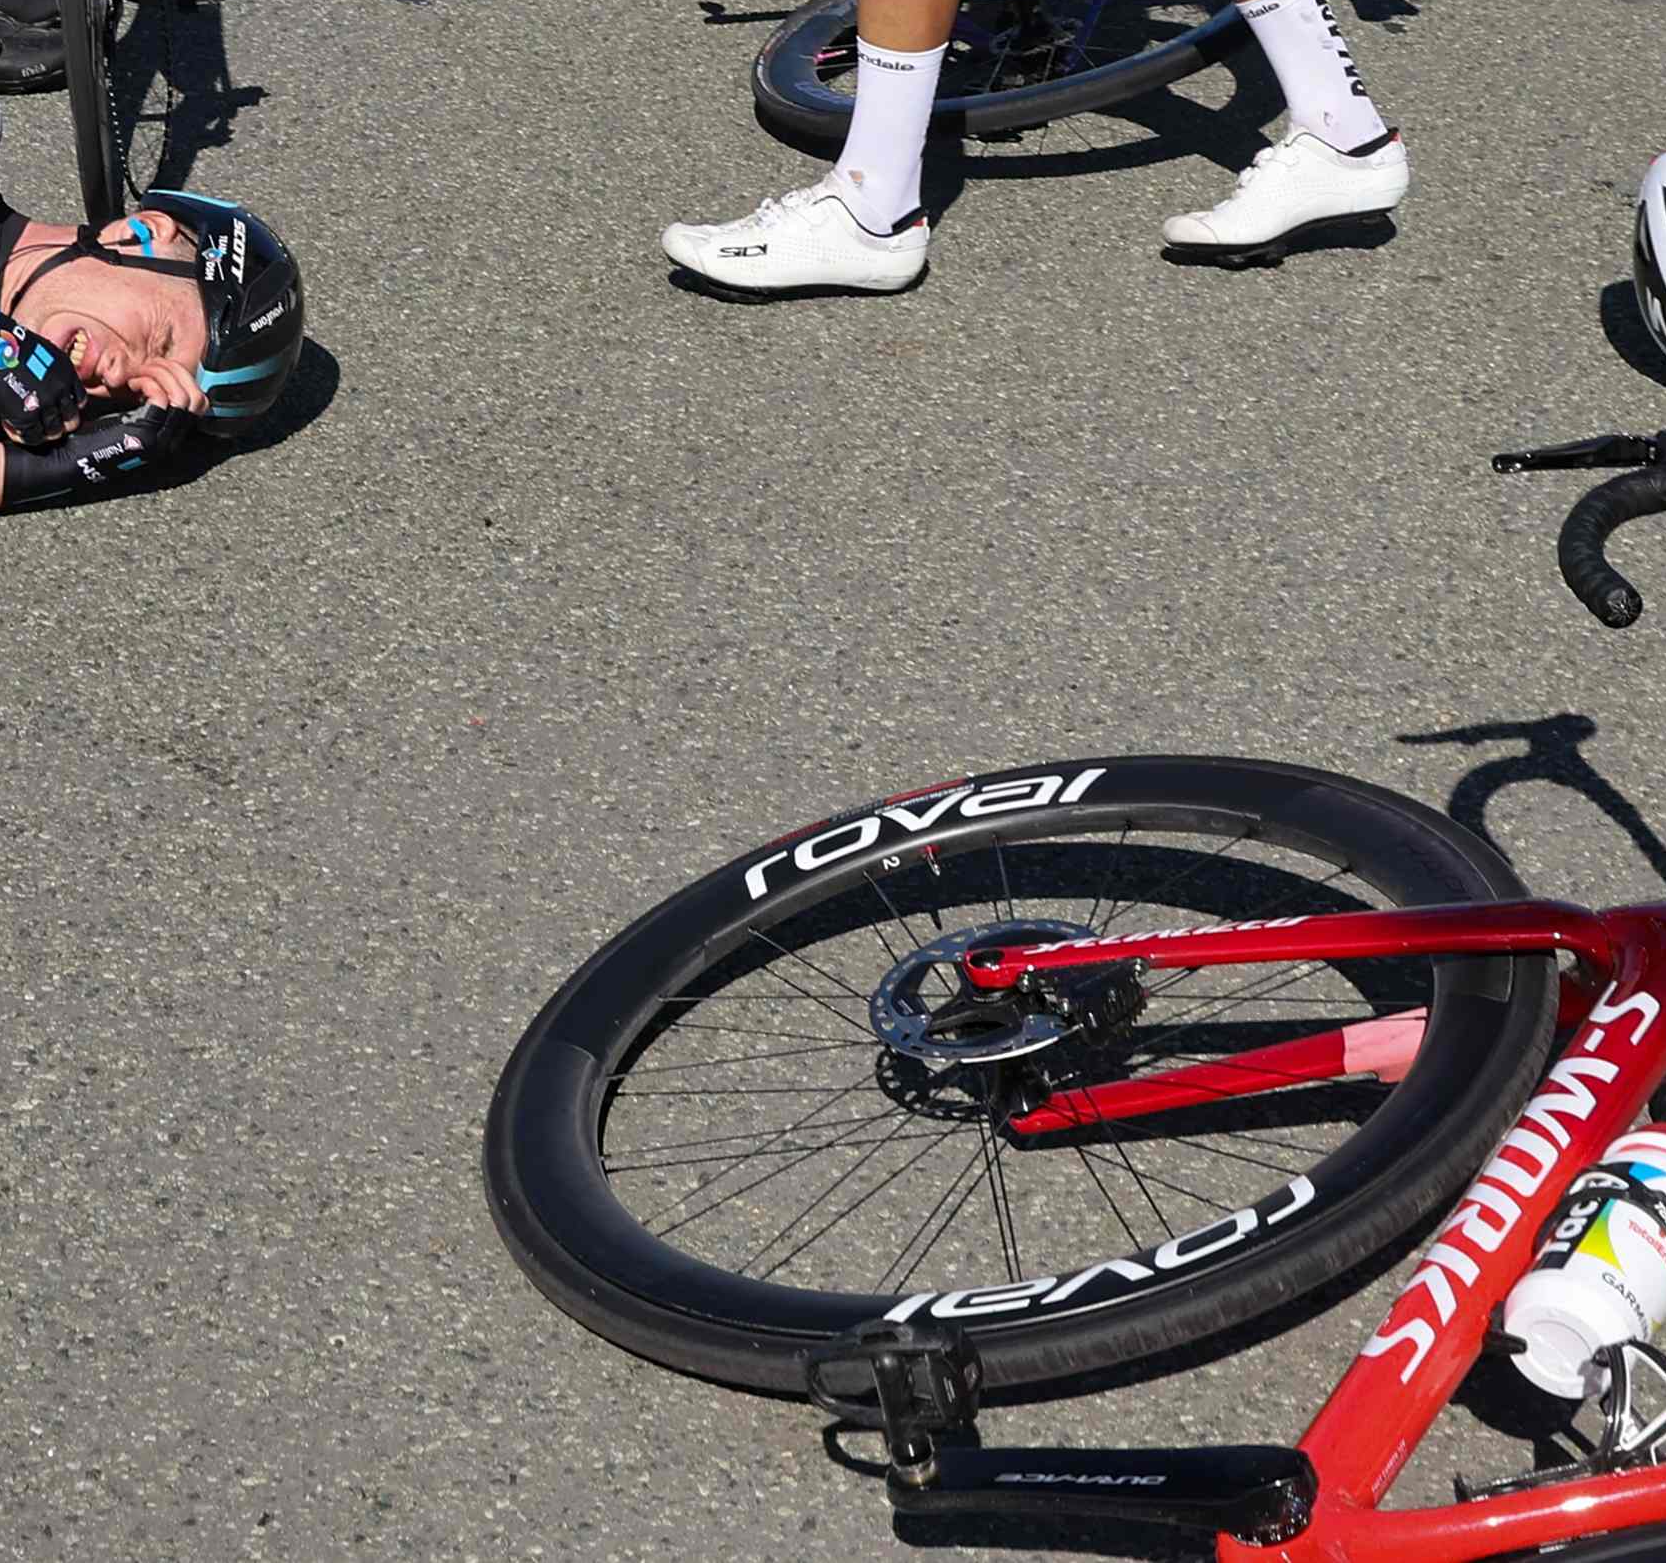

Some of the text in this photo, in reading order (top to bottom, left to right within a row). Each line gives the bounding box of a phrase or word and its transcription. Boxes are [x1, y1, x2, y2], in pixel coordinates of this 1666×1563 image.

[1244, 1, 1282, 20] dale
[857, 52, 916, 72] ndale
[231, 217, 247, 284] SCOTT
[203, 260, 215, 283] DSM
[249, 301, 286, 333] youfone
[742, 767, 1108, 901] roval
[881, 855, 901, 871] 2
[1360, 979, 1662, 1386] S-WORKS
[882, 1173, 1316, 1324] roval
